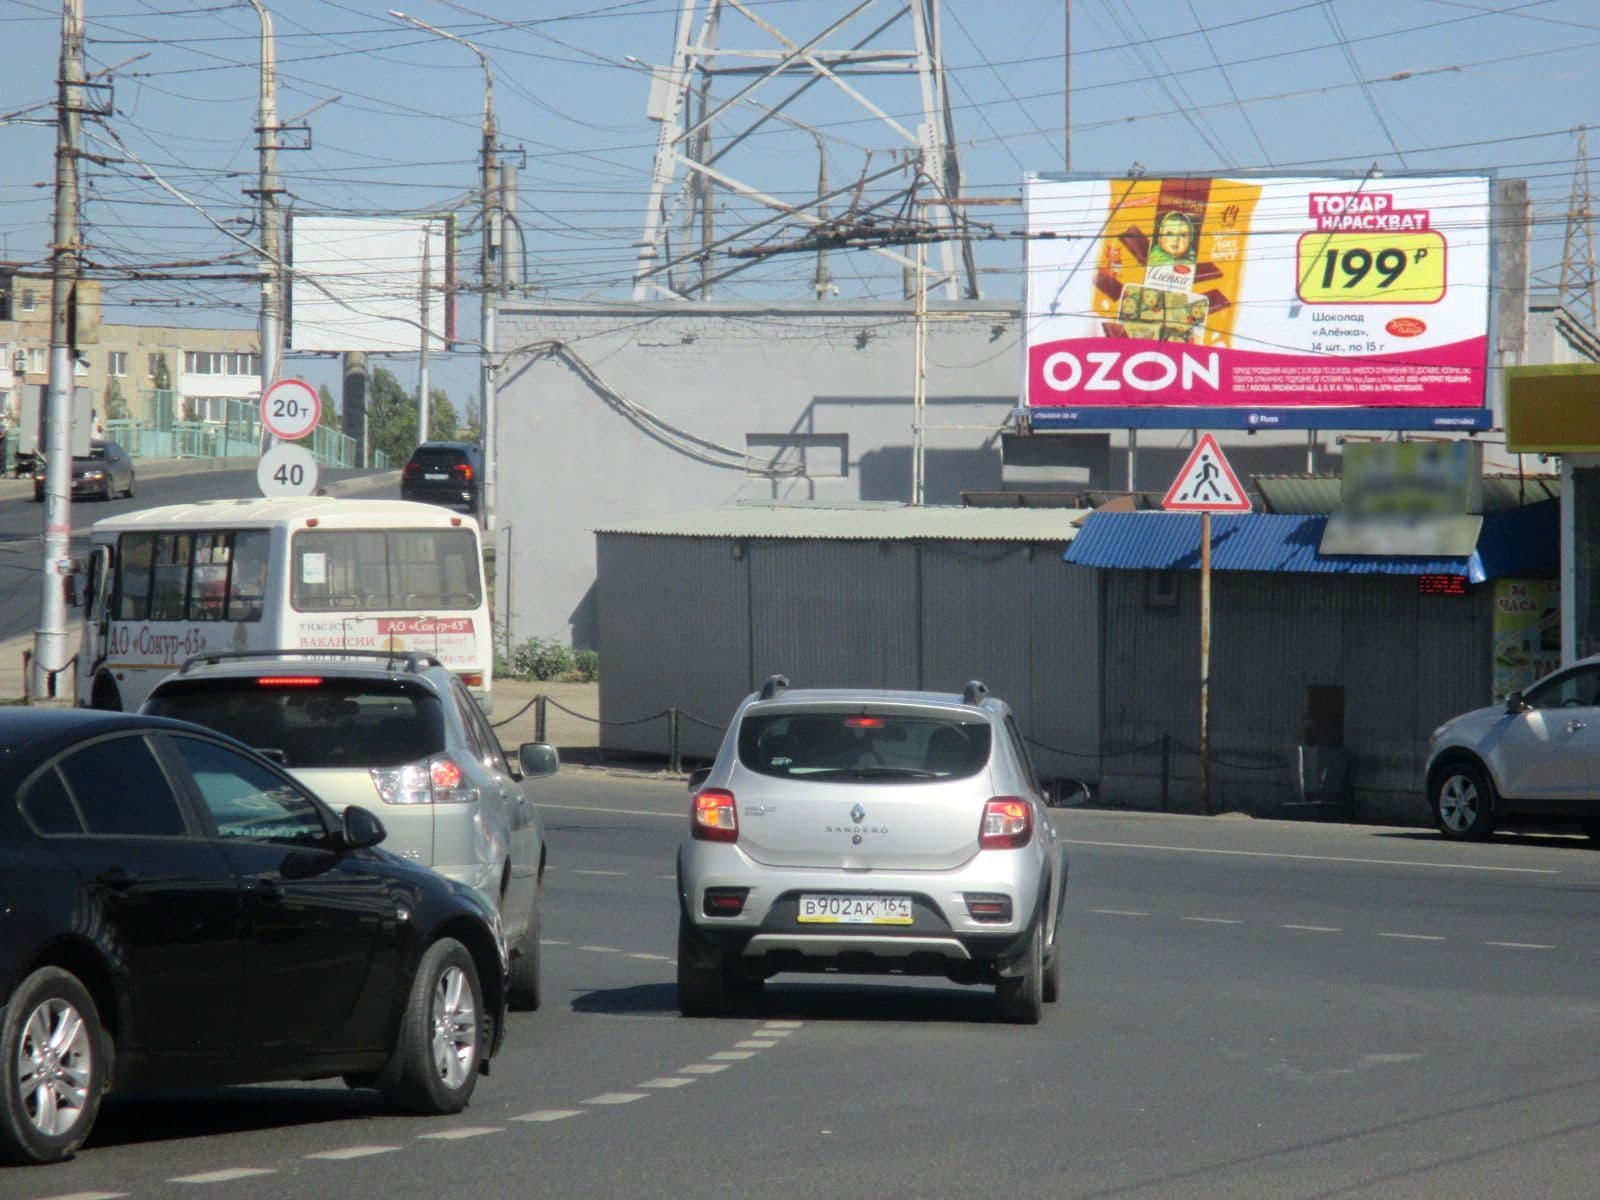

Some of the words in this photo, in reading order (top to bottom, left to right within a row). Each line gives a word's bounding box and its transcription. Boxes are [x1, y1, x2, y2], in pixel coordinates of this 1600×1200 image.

[1313, 195, 1388, 214] ТОВАР
[1322, 213, 1426, 230] НАРАСХВАТ
[1321, 247, 1408, 289] 199
[1312, 311, 1365, 323] Шоколад
[1312, 327, 1369, 337] «Алёнка»,
[1312, 342, 1322, 352] 14
[1366, 342, 1377, 351] 15
[1042, 351, 1220, 392] OZON
[1260, 415, 1279, 423] Russ
[273, 464, 304, 486] 40
[387, 621, 406, 632] АО
[109, 626, 129, 655] АО
[300, 636, 375, 648] ВАКАНСИИ
[825, 826, 888, 834] SANDERO
[805, 897, 876, 916] В902АК
[880, 898, 909, 912] 164
